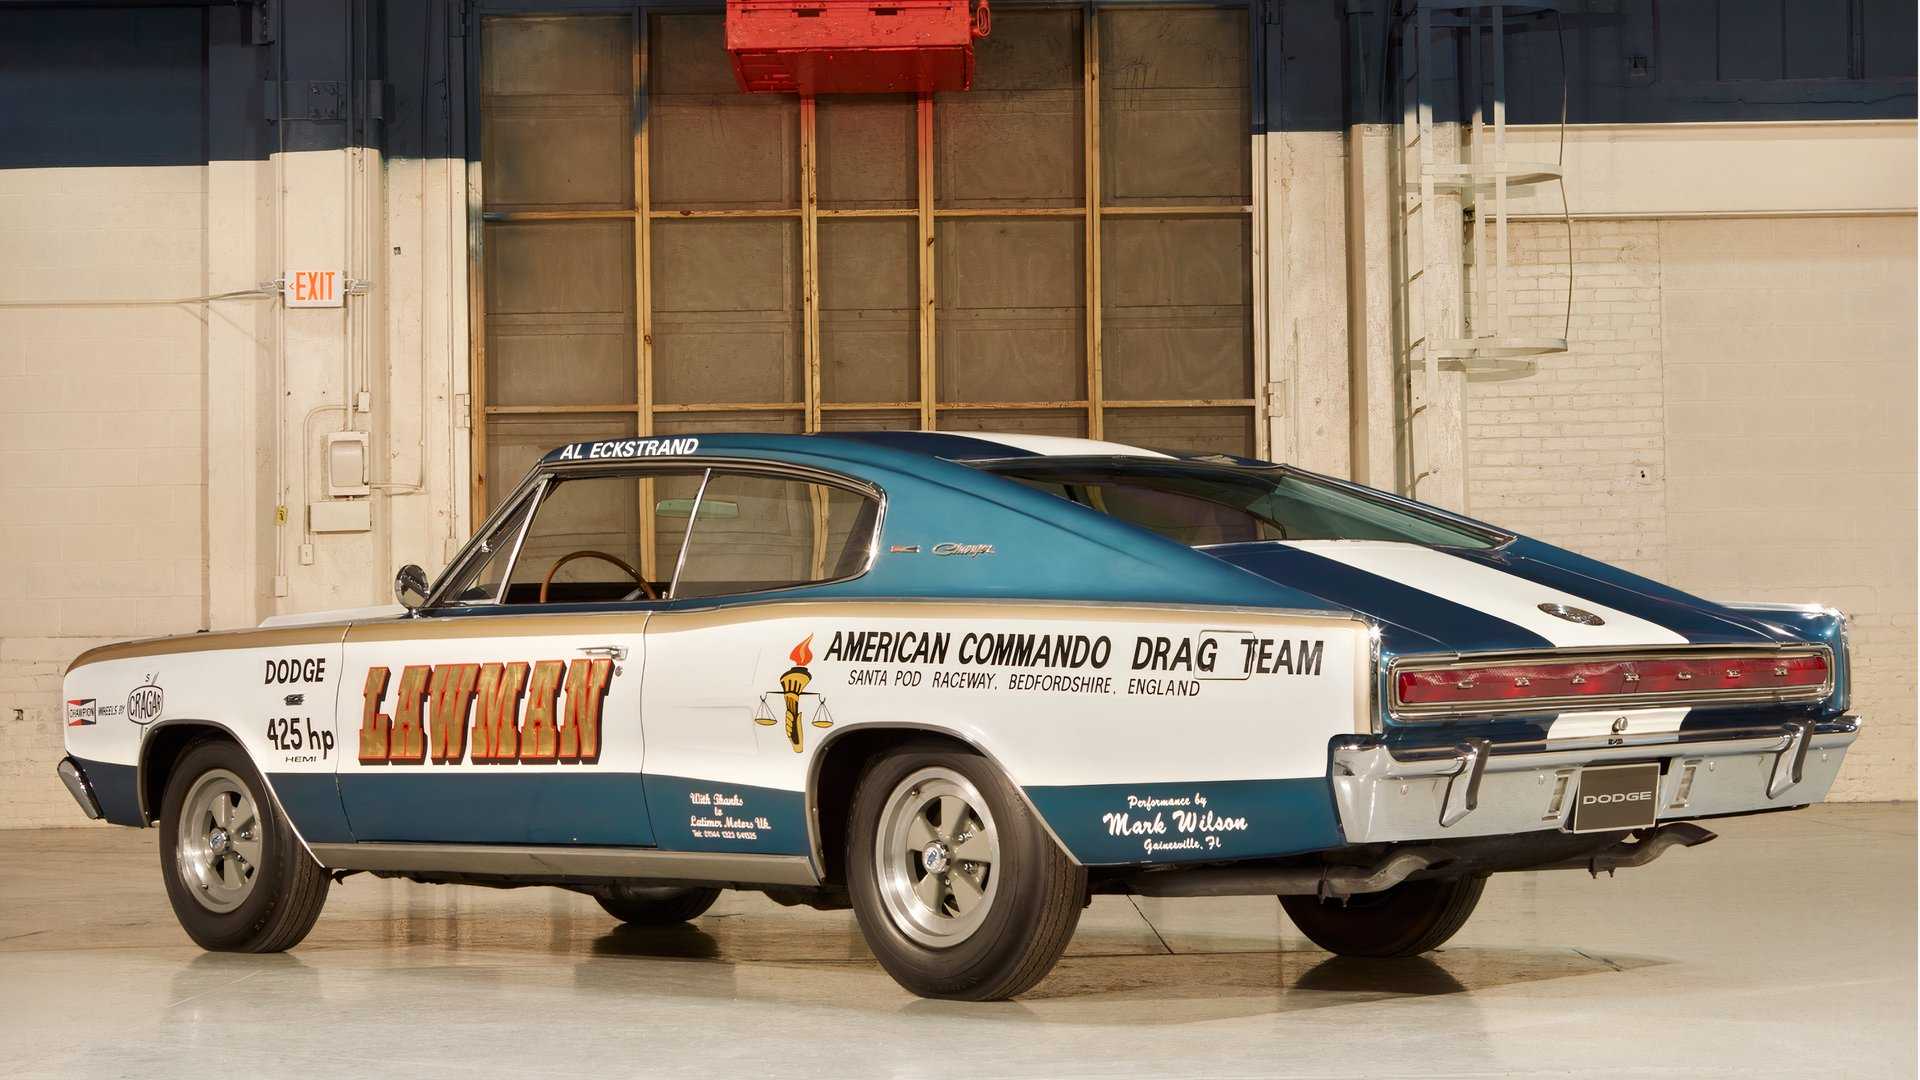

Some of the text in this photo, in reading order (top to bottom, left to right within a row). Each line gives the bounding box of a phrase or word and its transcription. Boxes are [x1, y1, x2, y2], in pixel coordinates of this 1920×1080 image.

[296, 271, 335, 300] EXIT
[560, 438, 699, 459] AL ECKSTRAND
[824, 631, 1324, 675] AMERICAN COMMANDO DRAG TEAM
[265, 658, 325, 684] DODGE
[848, 669, 887, 686] SANTA
[894, 671, 921, 687] POD
[1128, 678, 1200, 696] ENGLAND
[129, 690, 162, 719] CRAGAR
[358, 659, 616, 765] LAWMAN
[267, 717, 334, 760] 425 hp
[689, 792, 744, 807] With Thanks
[1127, 792, 1207, 811] Performance by
[1582, 790, 1652, 806] DODGE
[714, 806, 724, 817] to
[724, 817, 754, 829] Motors
[1102, 809, 1248, 836] Mark Wilson
